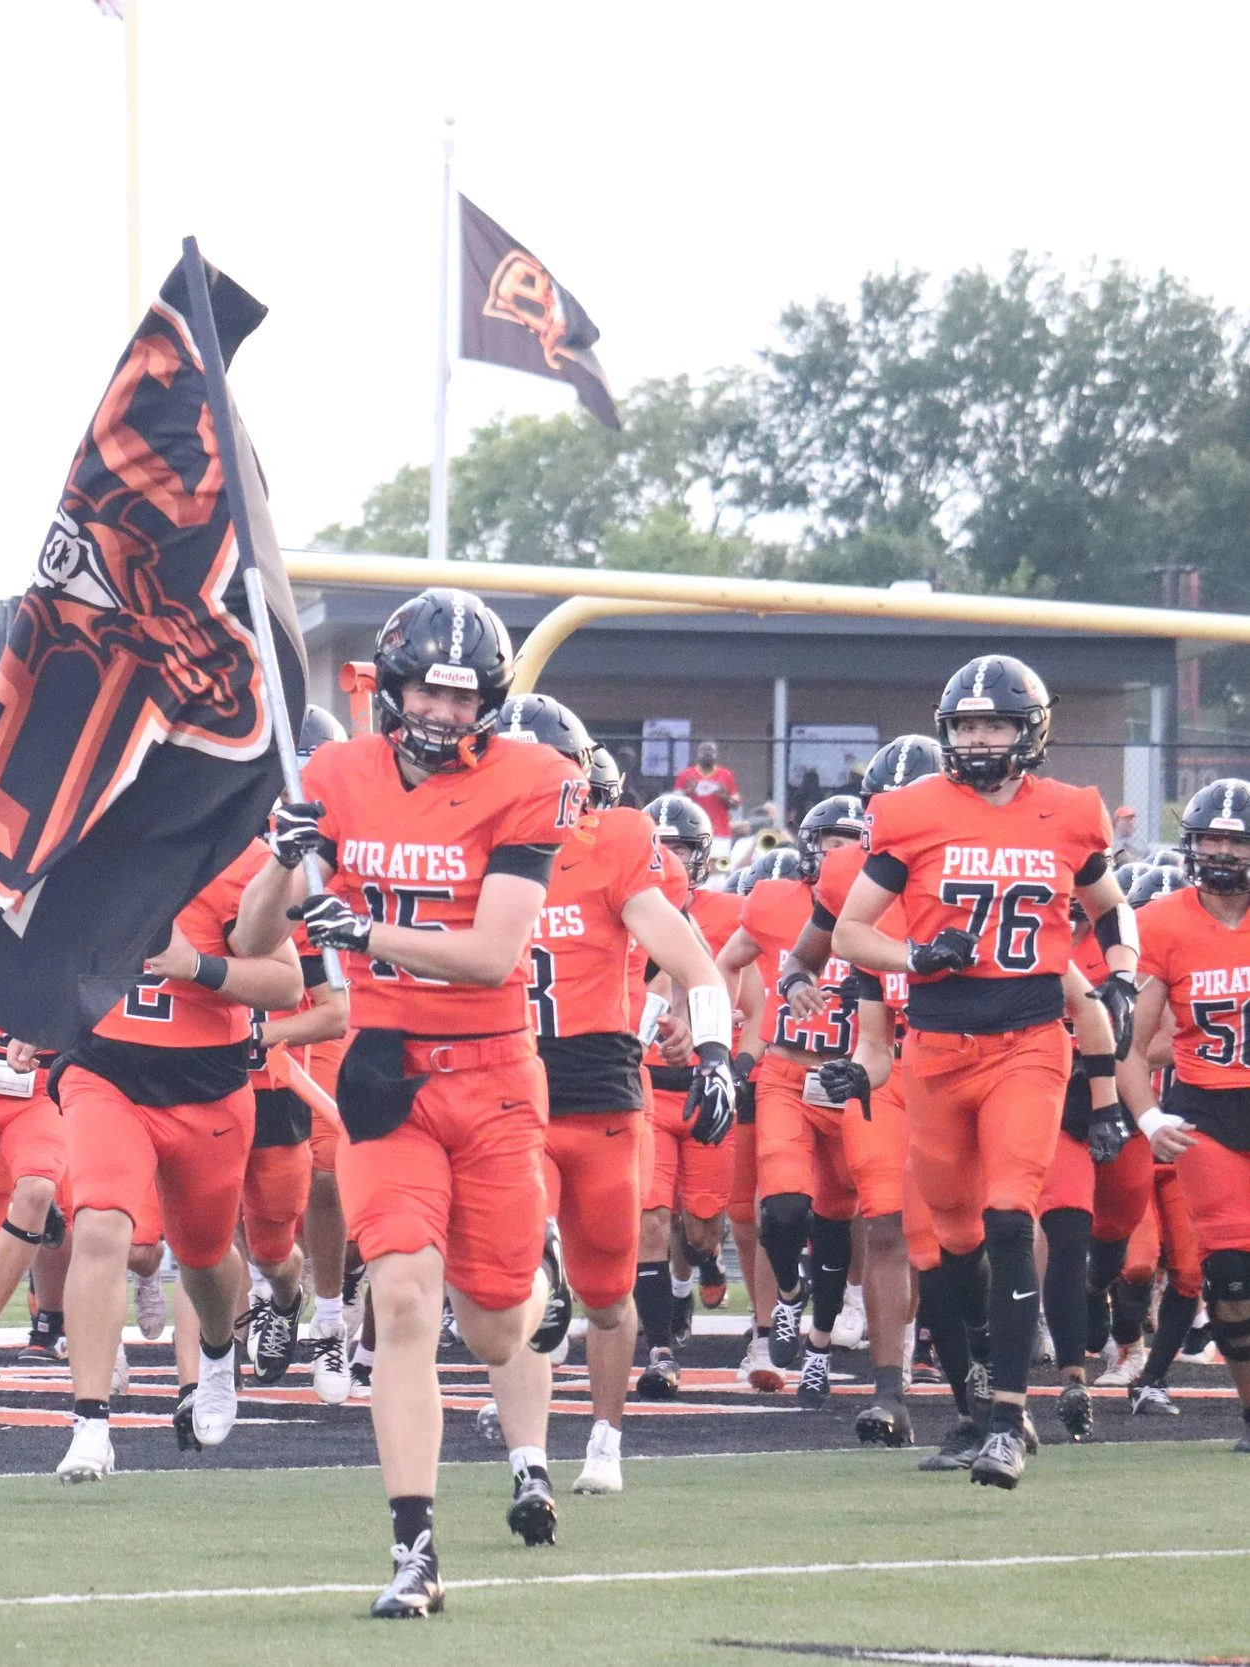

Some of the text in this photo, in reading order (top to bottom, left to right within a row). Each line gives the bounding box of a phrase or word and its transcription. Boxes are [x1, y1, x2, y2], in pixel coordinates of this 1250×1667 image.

[431, 669, 474, 684] Riddell
[342, 839, 467, 881] PIRATES
[942, 846, 1056, 878] PIRATES
[361, 881, 454, 985] 15
[940, 879, 1056, 972] 76
